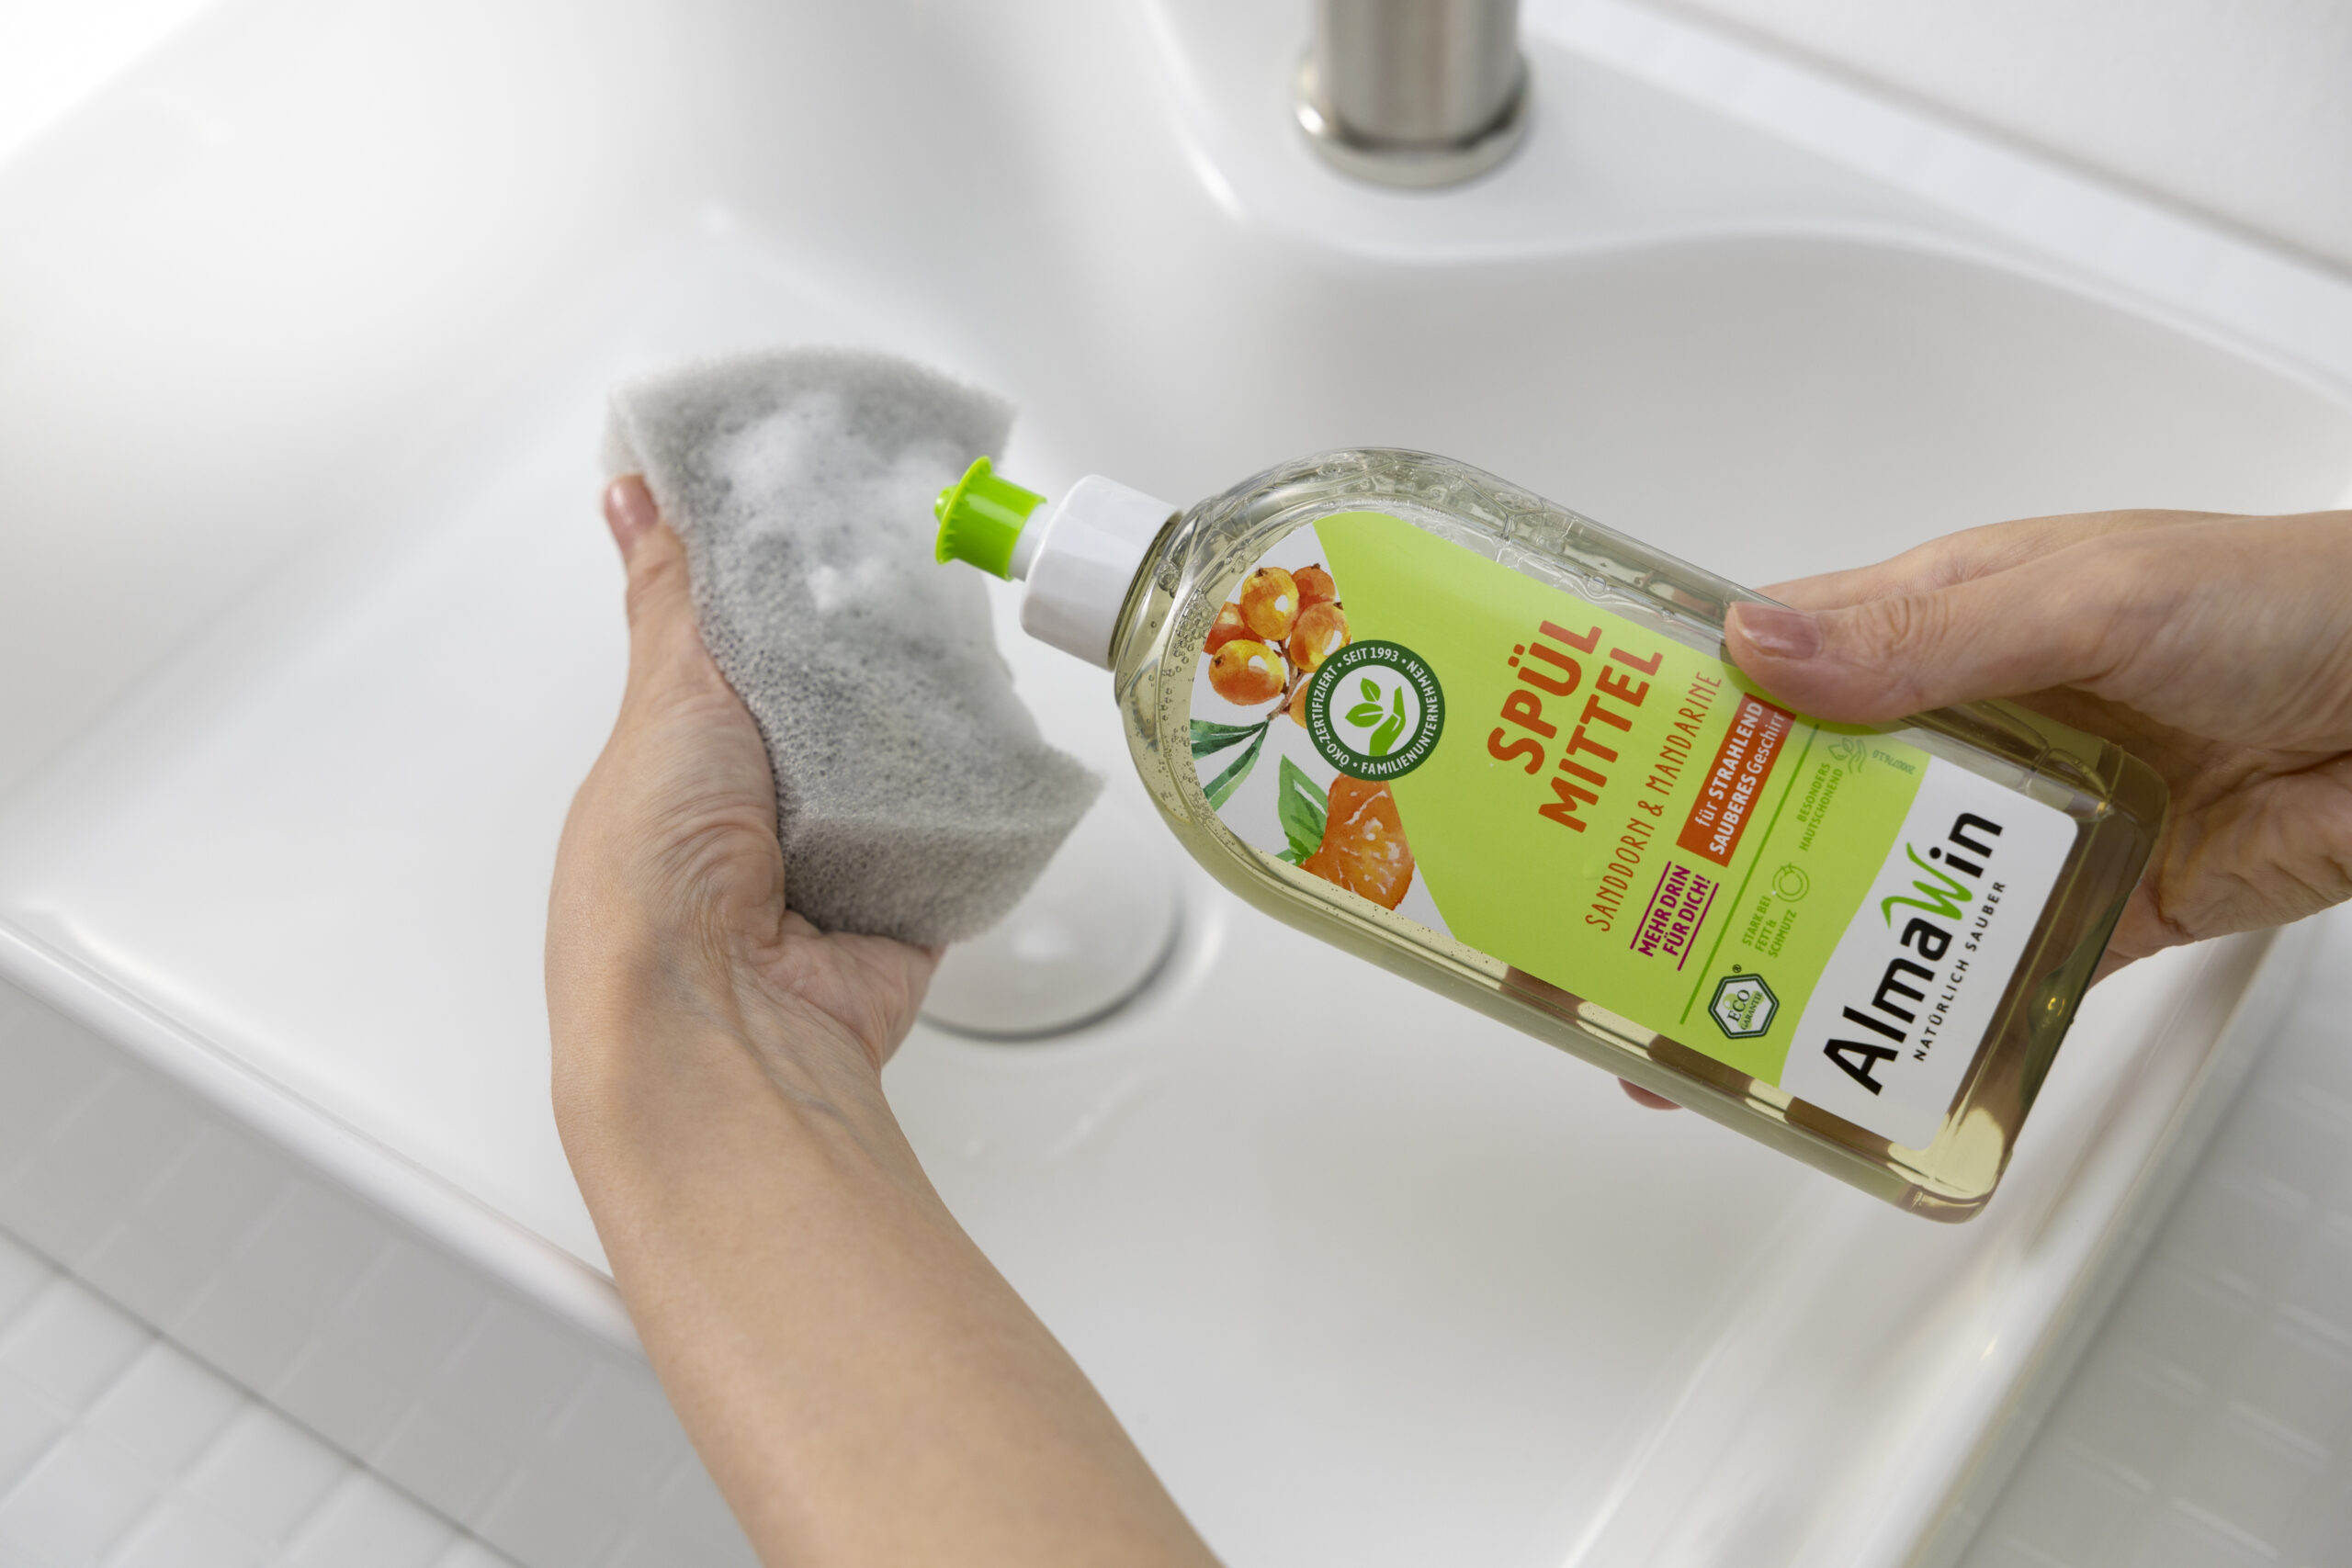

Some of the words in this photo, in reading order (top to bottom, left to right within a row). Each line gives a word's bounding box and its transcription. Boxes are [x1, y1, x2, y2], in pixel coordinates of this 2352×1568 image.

[1342, 648, 1367, 666] SEIT
[1369, 647, 1399, 662] 1993
[1487, 619, 1602, 775] SPÜL
[1312, 665, 1350, 767] ÖKO-ZERTIFIZIERT
[1361, 660, 1439, 775] FAMILIENUNTERNEHMEN
[1538, 647, 1663, 833] MITTEL
[1645, 671, 1722, 795] MANDARINE
[1637, 800, 1663, 817] &
[1695, 800, 1719, 828] für
[1708, 701, 1763, 800] STRAHLEND
[1709, 773, 1757, 855] SAUBERES
[1747, 712, 1786, 774] Geschirr
[1796, 762, 1831, 823] BESONDERS
[1798, 768, 1843, 852] HAUTSCHONEND
[1585, 818, 1655, 931] SANDDORN
[1638, 909, 1668, 957] MEHR
[1660, 864, 1691, 911] DRIN
[1663, 920, 1690, 956] FÜR
[1679, 874, 1712, 922] DICH!
[1742, 913, 1765, 947] STARK
[1756, 896, 1771, 916] BEI
[1755, 926, 1774, 953] FETT
[1768, 908, 1797, 959] SCHMUTZ
[1823, 812, 2003, 1096] AlmaWin
[1726, 989, 1750, 1022] ECO
[1740, 990, 1764, 1031] GARANTIE
[1913, 959, 1970, 1061] NATÜRLICH
[1965, 881, 2006, 952] SAUBER
